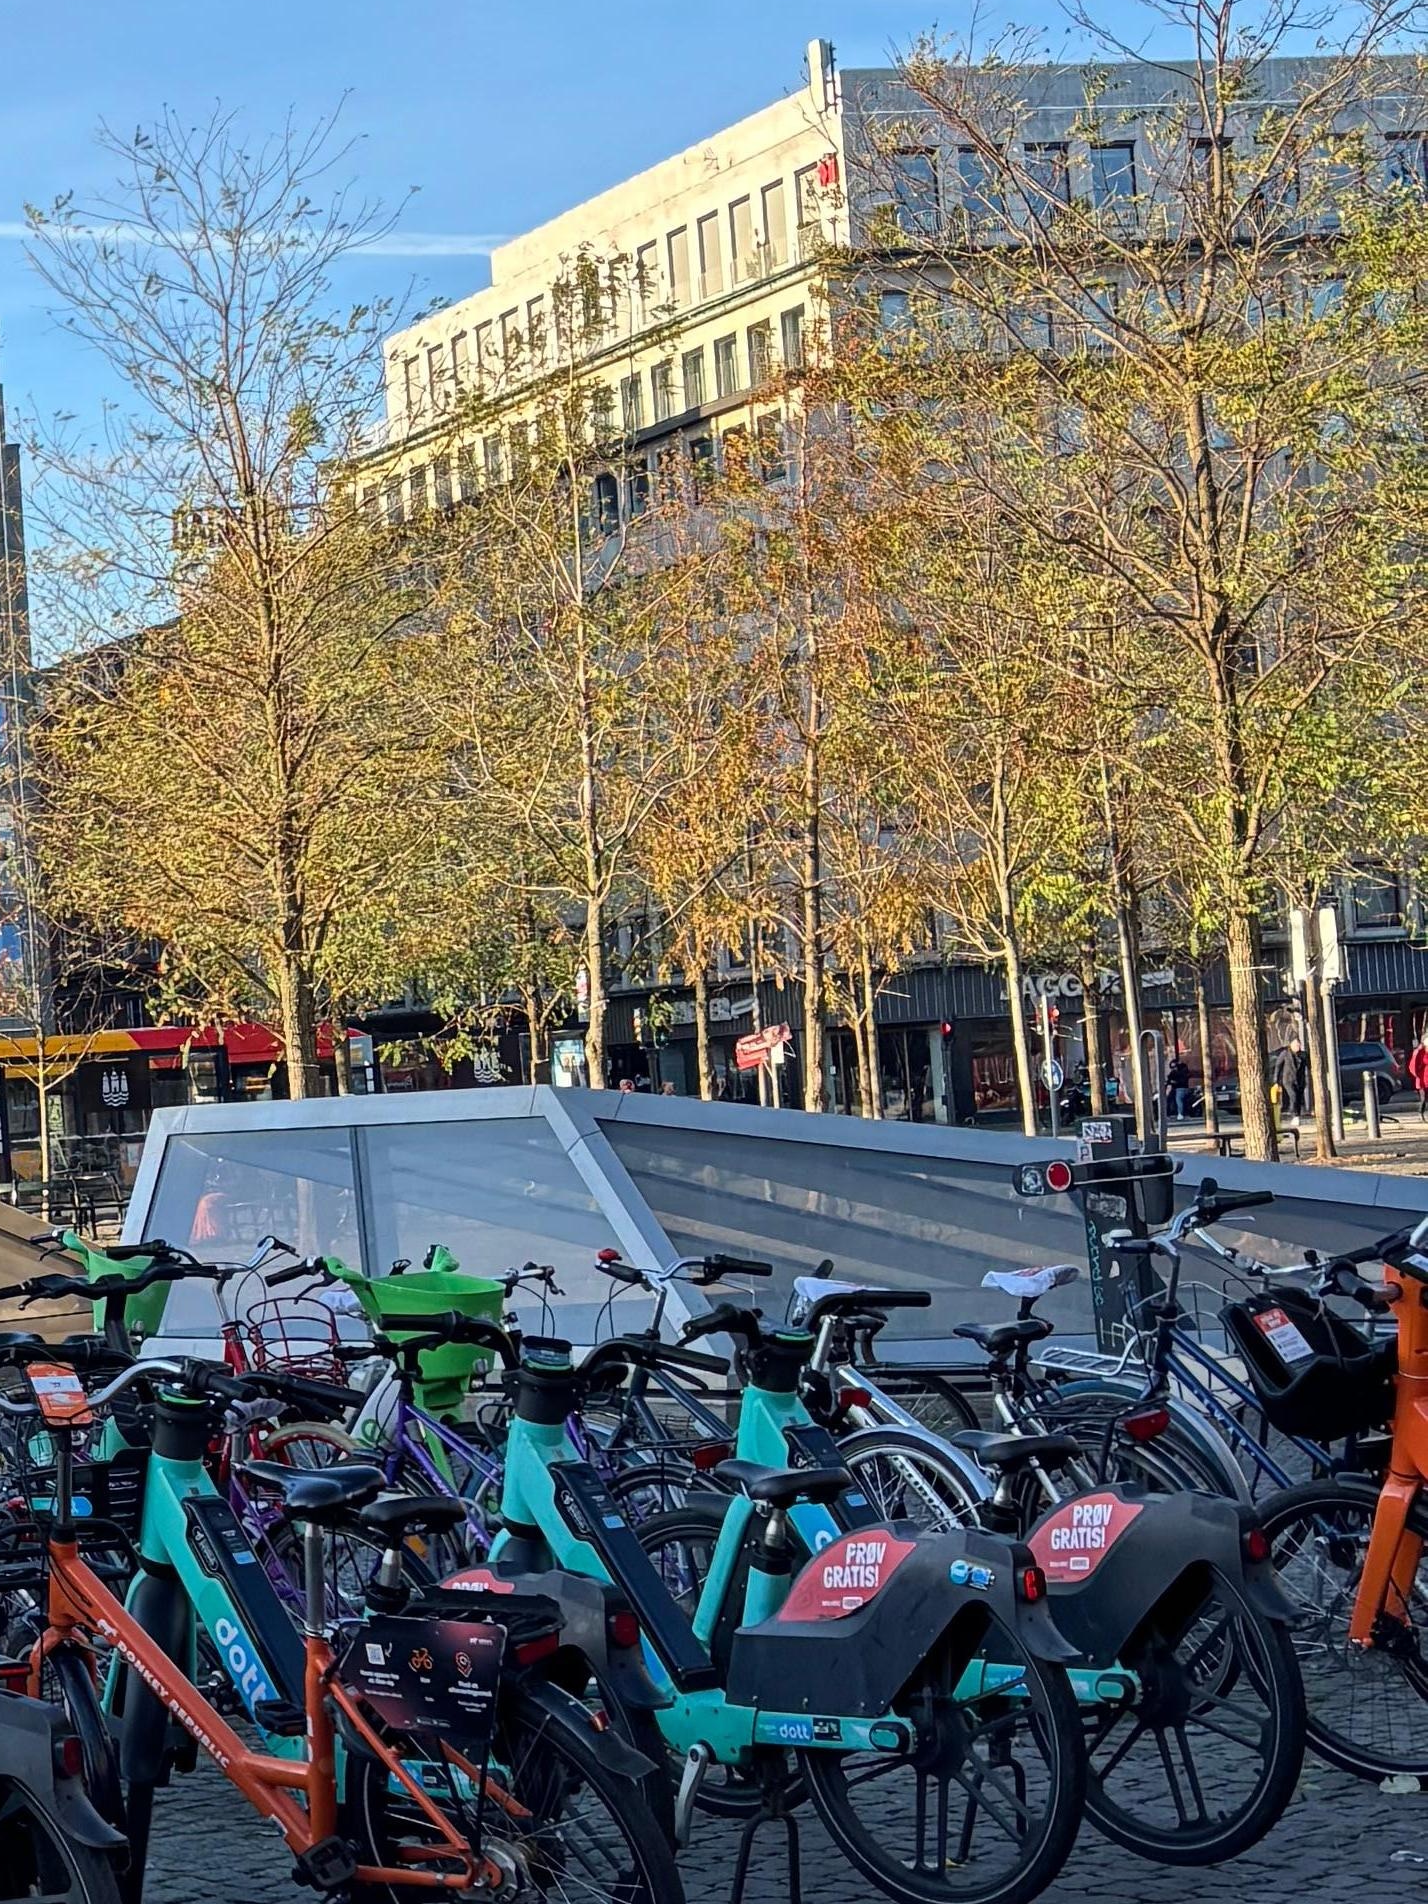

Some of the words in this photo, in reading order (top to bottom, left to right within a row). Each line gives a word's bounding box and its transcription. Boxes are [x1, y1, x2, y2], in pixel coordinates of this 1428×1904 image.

[1072, 1503, 1113, 1527] PRØV
[1051, 1526, 1106, 1550] GRATIS!
[846, 1541, 887, 1565] PRØV
[823, 1565, 879, 1589] GRATIS!
[117, 1641, 169, 1698] DONKEY
[168, 1698, 231, 1769] REPUBLIC
[778, 1720, 812, 1740] dott
